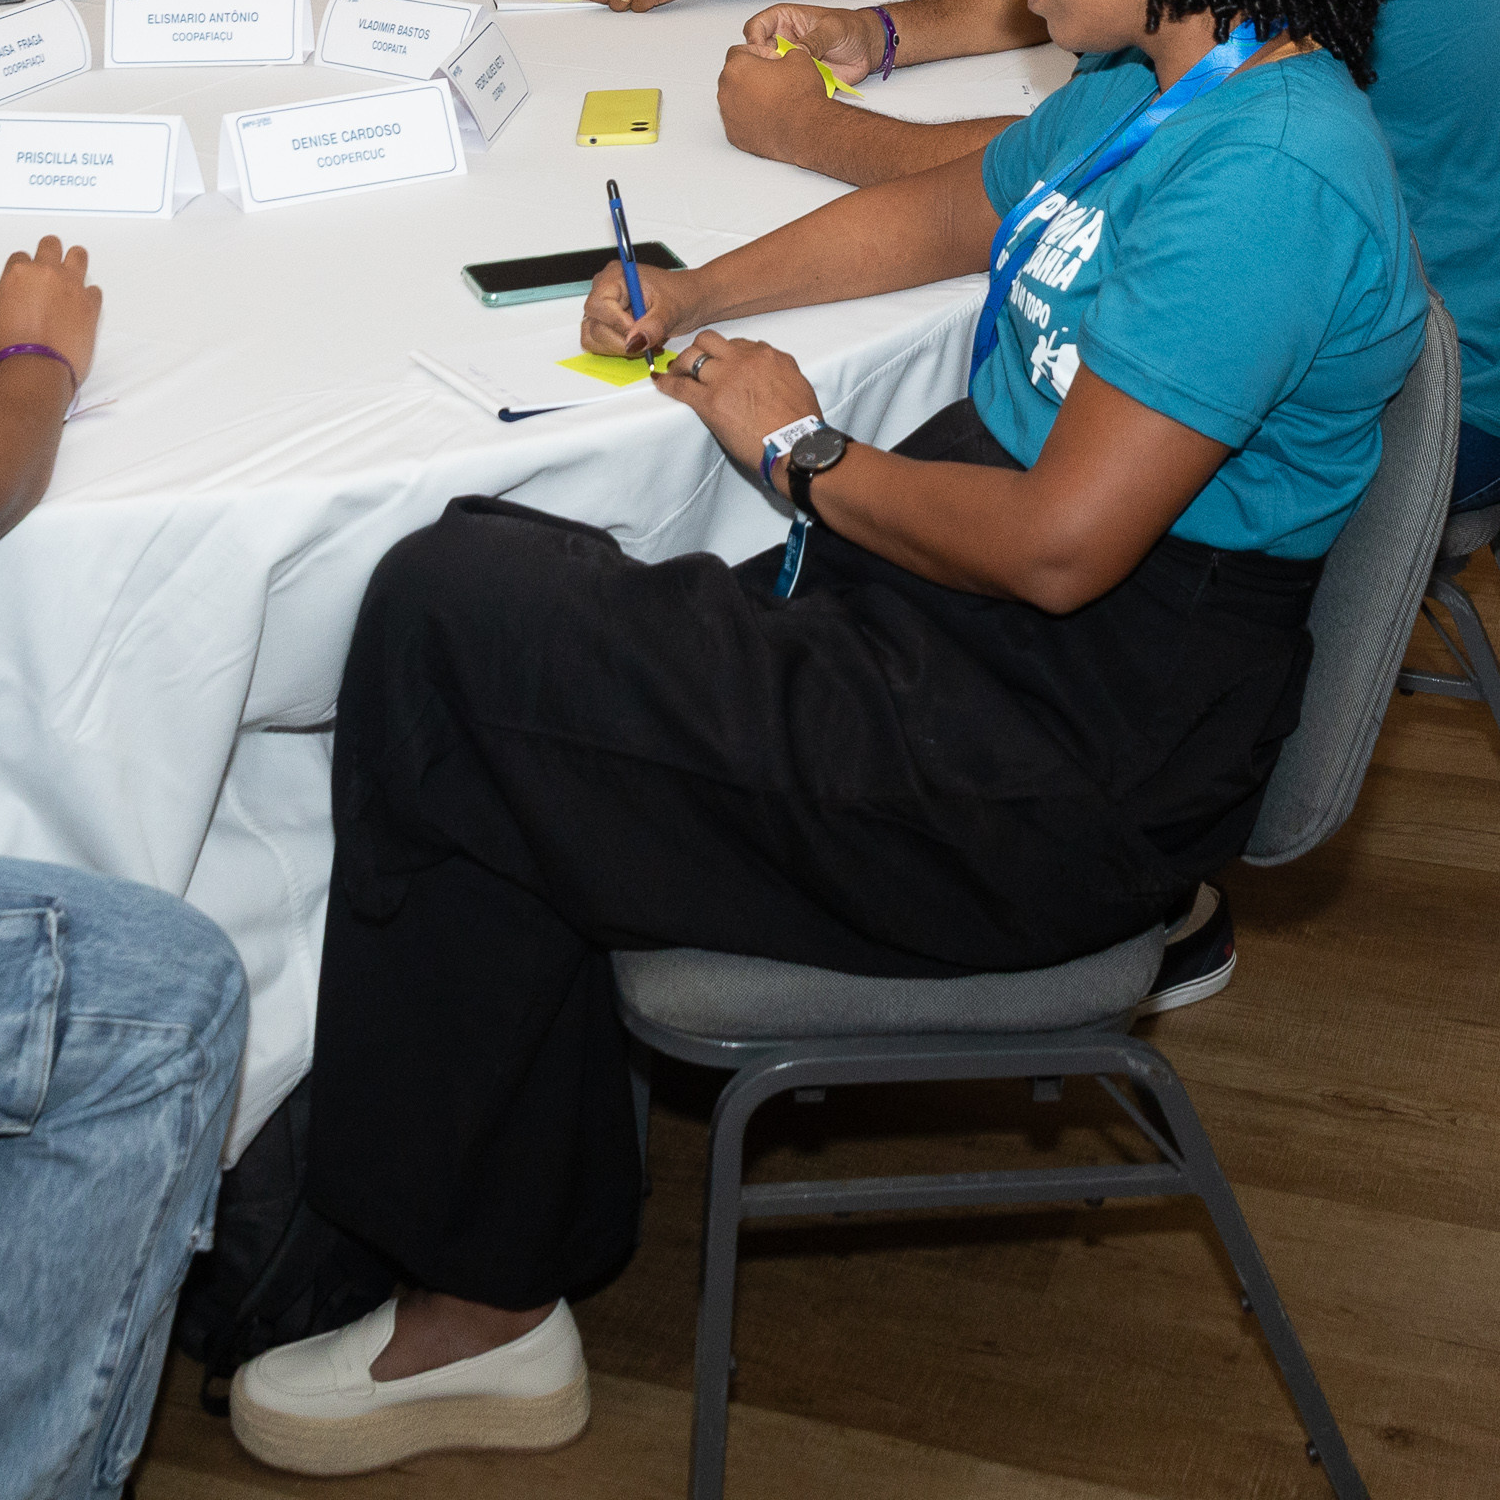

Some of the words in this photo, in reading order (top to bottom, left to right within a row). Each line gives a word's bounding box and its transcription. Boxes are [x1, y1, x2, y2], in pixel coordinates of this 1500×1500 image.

[147, 12, 206, 24] ELISMARIO
[209, 9, 259, 23] ANTÔNIO
[172, 31, 233, 42] COOPAFIAÇU
[358, 18, 396, 34] VLADIMIR
[396, 24, 431, 40] BASTOS
[291, 133, 338, 150] DENISE
[341, 123, 402, 143] CARDOSO
[16, 151, 77, 165] PRISCILLA
[80, 153, 114, 166] SILVA
[316, 147, 386, 168] COOPERCUC
[28, 174, 97, 187] COOPERCUC
